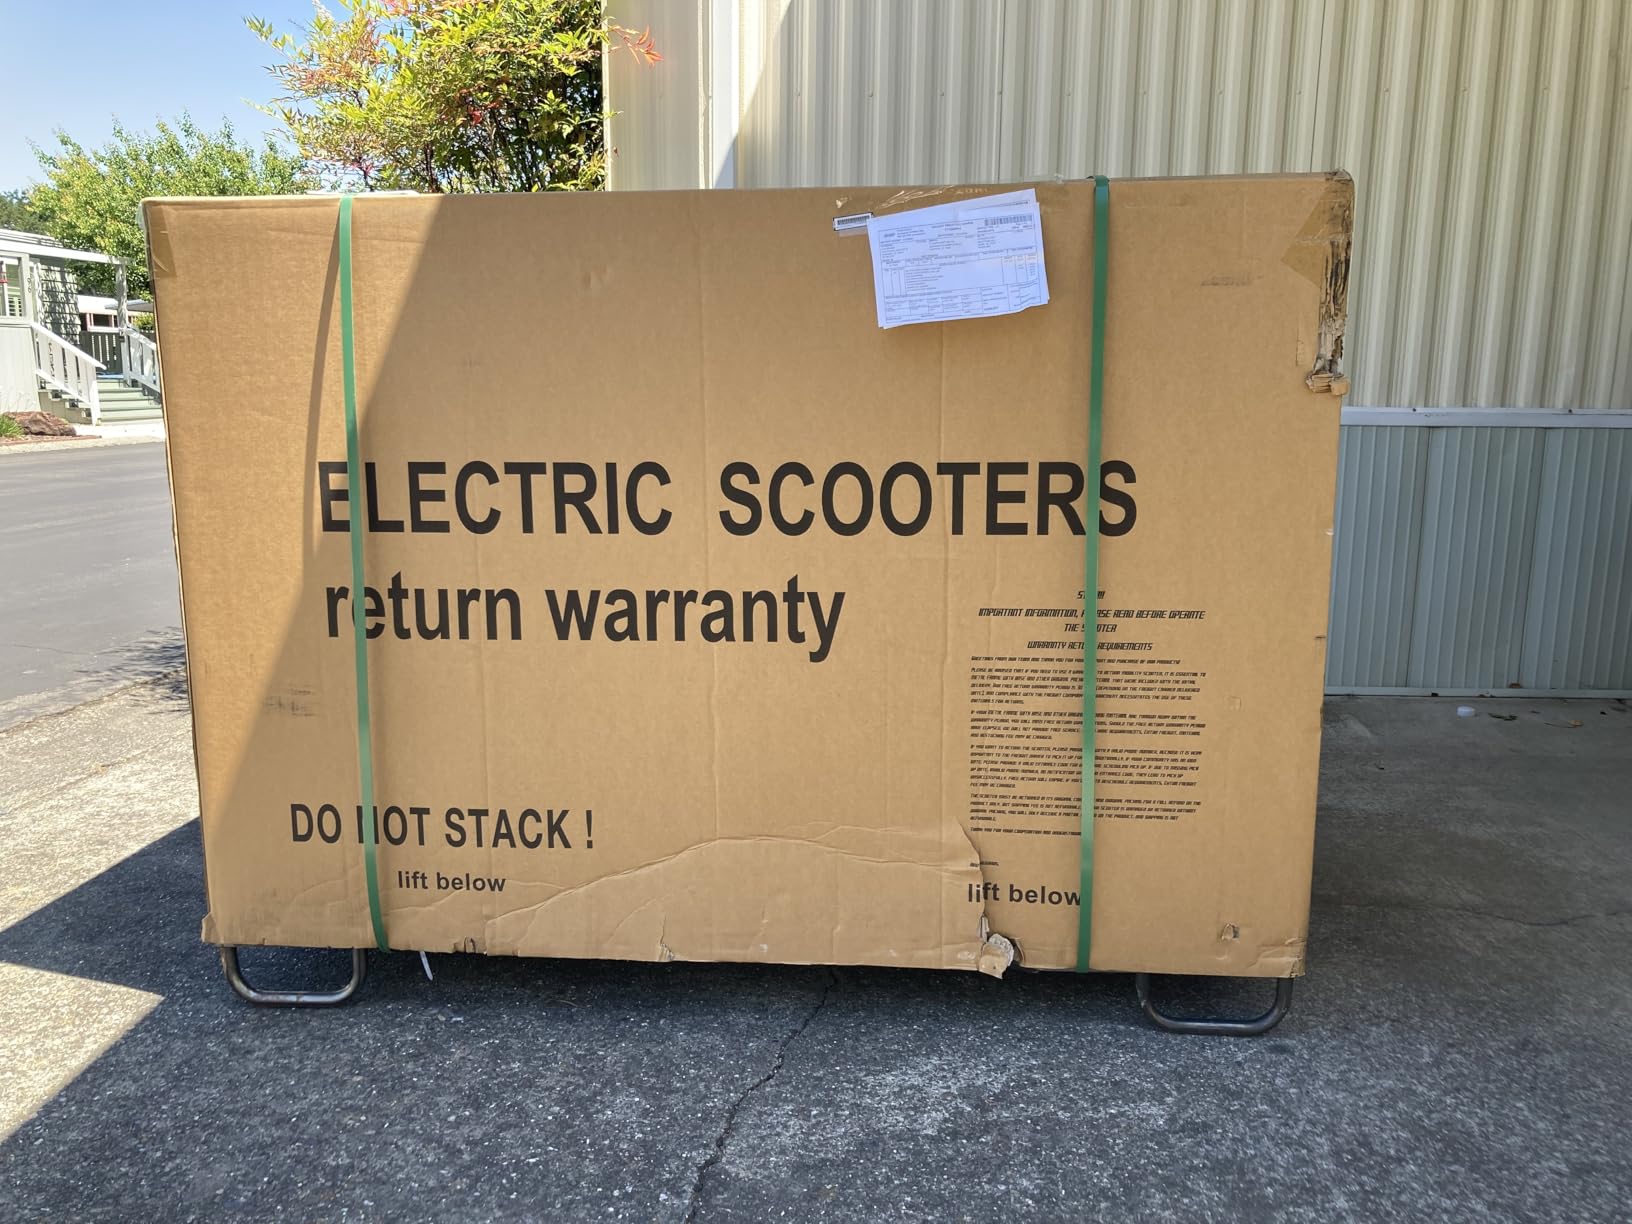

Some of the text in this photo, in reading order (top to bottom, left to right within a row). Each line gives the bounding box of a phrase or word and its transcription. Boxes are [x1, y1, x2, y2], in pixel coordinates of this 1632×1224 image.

[319, 460, 1137, 537] ELECTRIC SCOOTERS
[326, 571, 846, 663] return warranty
[979, 608, 1024, 617] IMPORTANT
[1136, 610, 1168, 619] BEFORE
[1064, 623, 1080, 632] THE
[1027, 641, 1067, 649] WARRANTY
[291, 804, 341, 844] DO
[445, 808, 572, 849] STACK
[586, 810, 593, 849] !
[398, 871, 507, 892] lift below
[968, 882, 1081, 906] lift below
